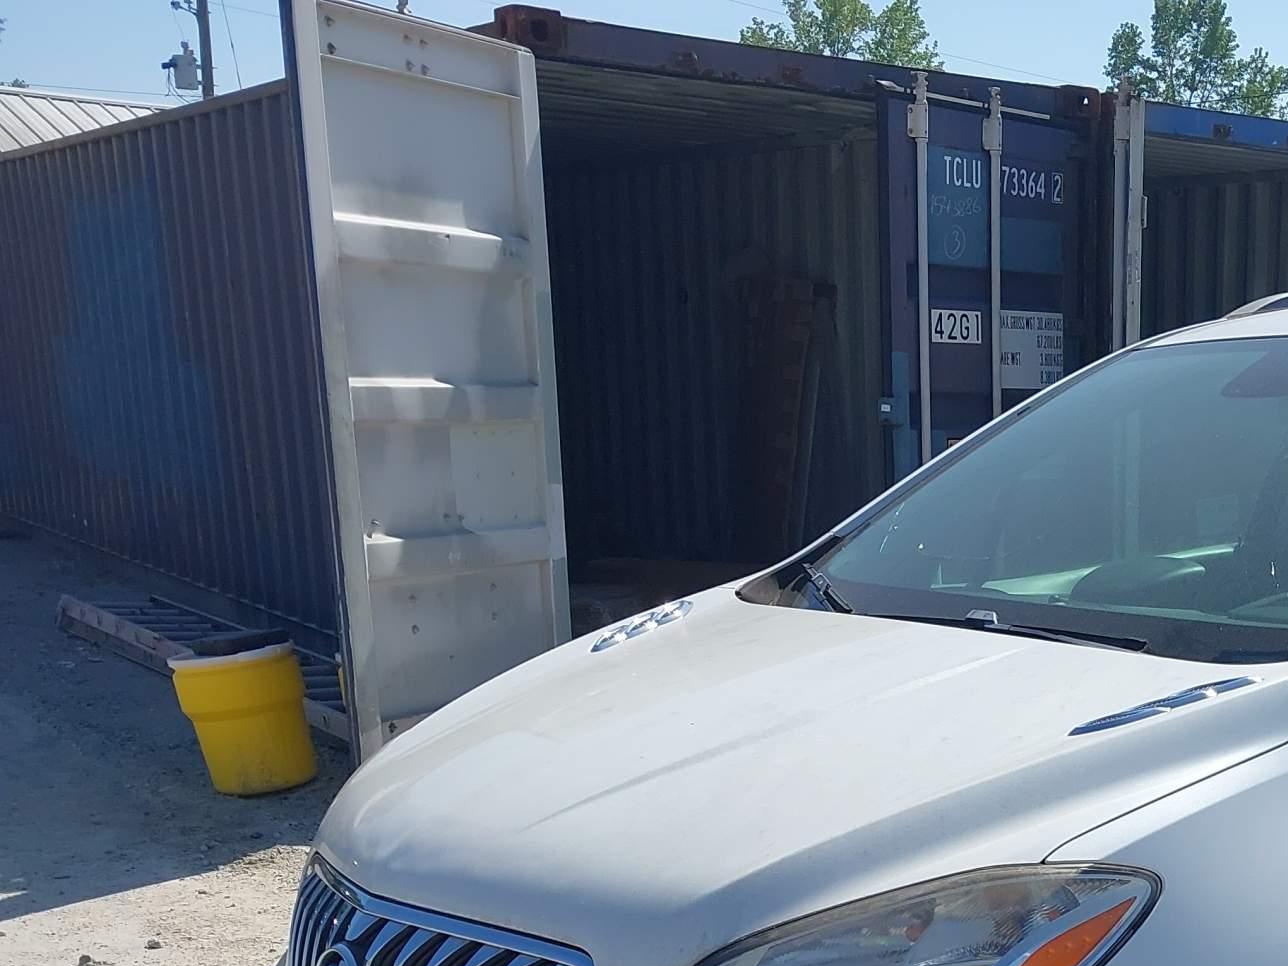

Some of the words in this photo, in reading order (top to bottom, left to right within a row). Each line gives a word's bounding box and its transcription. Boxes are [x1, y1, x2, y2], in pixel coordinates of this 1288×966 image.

[943, 155, 982, 189] TCLU
[1000, 166, 1045, 200] 73364
[934, 311, 981, 342] 42G1
